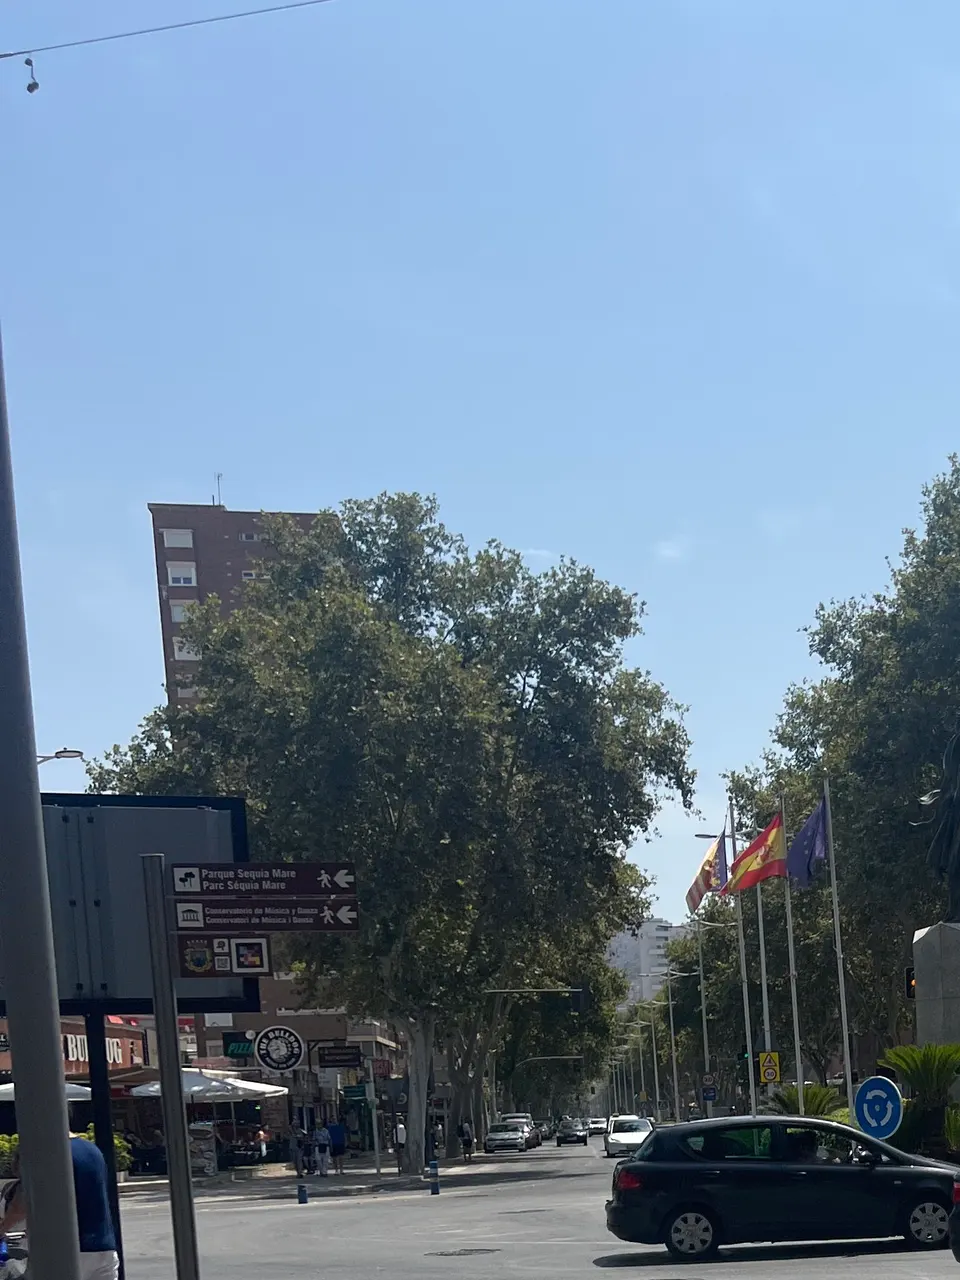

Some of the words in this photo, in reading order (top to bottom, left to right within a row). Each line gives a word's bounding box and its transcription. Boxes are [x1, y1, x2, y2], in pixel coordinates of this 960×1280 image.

[201, 869, 234, 880] Parque
[272, 869, 296, 878] Mare
[203, 881, 225, 890] Parc
[262, 881, 286, 890] Mare
[205, 916, 249, 924] Conservatori
[267, 1030, 300, 1054] BULLDOG
[67, 1034, 123, 1064] BUOG
